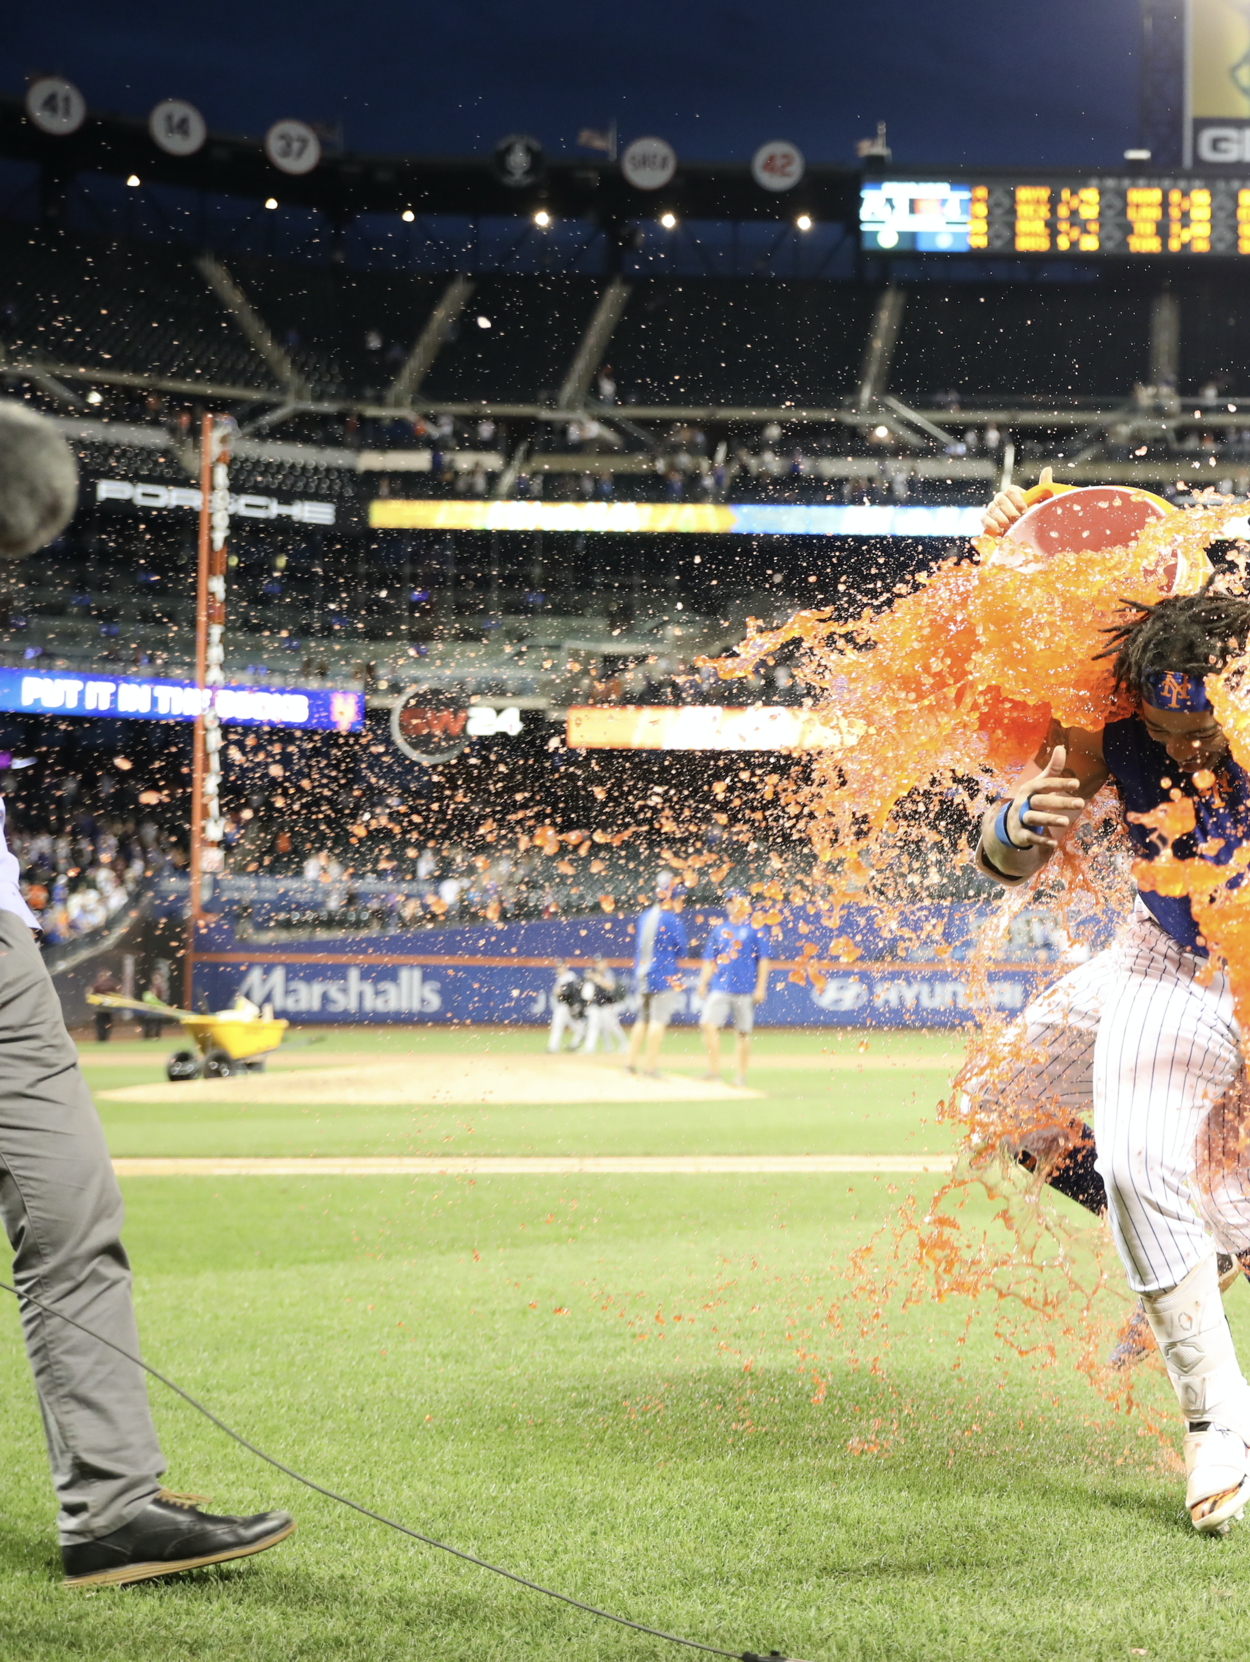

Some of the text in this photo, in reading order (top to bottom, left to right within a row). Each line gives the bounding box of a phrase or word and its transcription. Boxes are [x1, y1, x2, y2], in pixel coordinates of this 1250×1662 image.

[40, 91, 72, 118] 41
[164, 112, 191, 140] 14
[278, 131, 308, 160] 37
[761, 152, 797, 178] 42
[96, 478, 337, 526] PORCHE
[21, 676, 84, 709] PUT
[85, 680, 117, 711] IT
[1160, 670, 1192, 709] NY
[231, 964, 442, 1013] Marshalls
